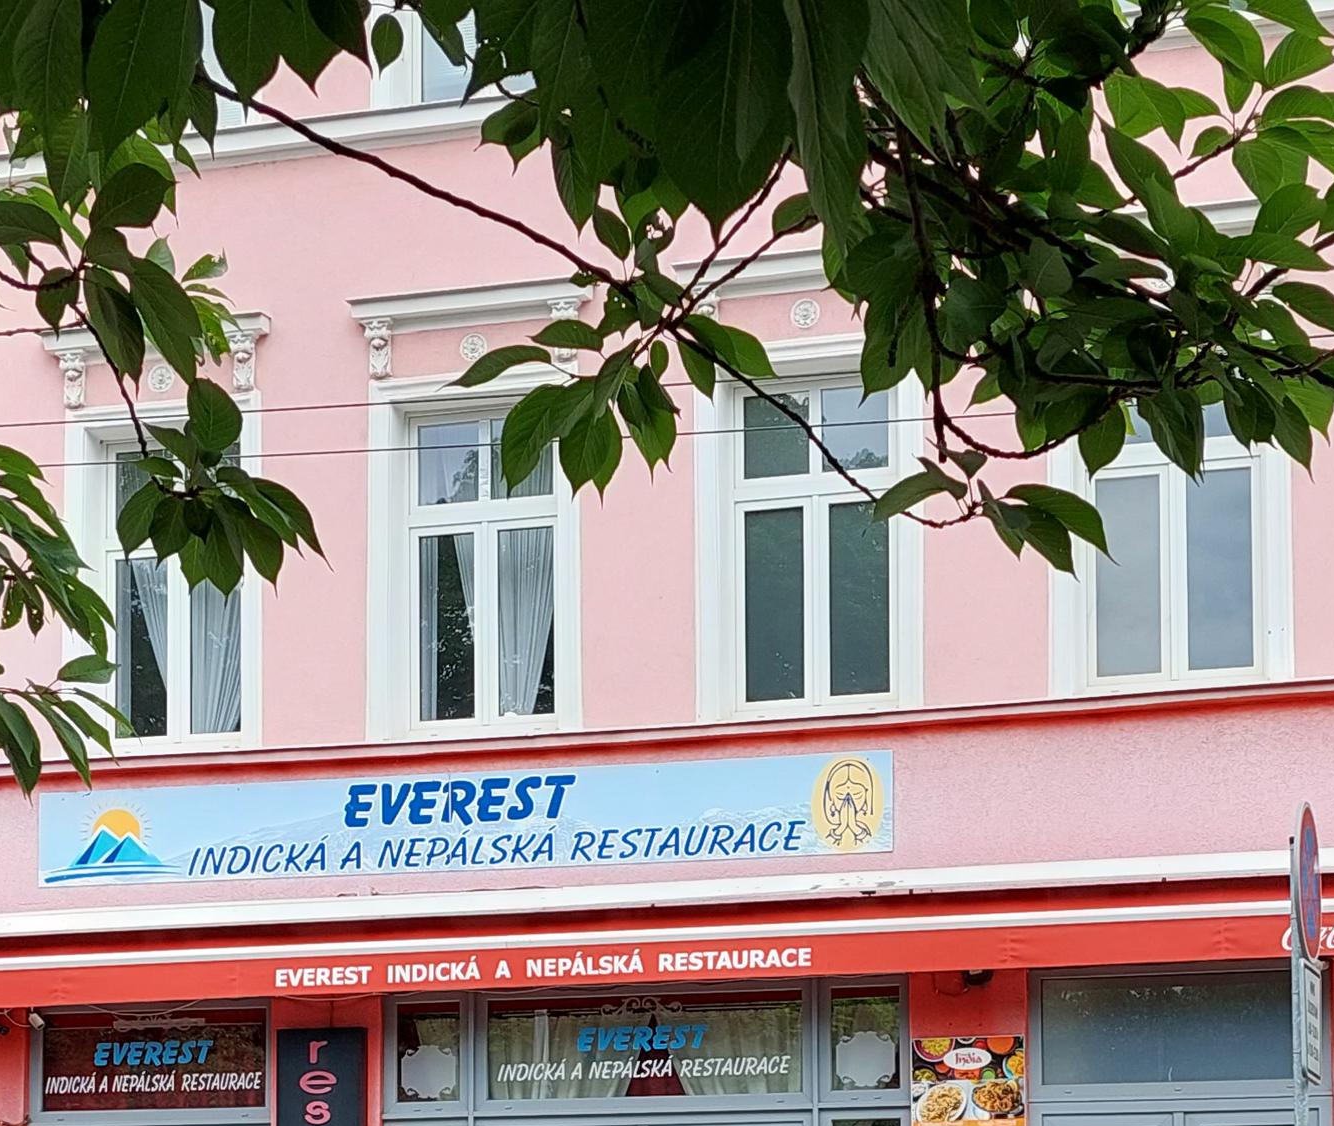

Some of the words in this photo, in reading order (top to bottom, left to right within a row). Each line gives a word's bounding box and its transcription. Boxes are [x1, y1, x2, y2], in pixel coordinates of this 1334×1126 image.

[343, 774, 576, 829] EVEREST
[186, 832, 329, 877] INDICKÁ
[339, 842, 363, 870] A
[377, 824, 557, 868] NEPÁLSKÁ
[570, 819, 807, 860] RESTAURACE
[273, 965, 372, 988] EVEREST
[386, 954, 481, 984] INDICKÁ
[495, 960, 511, 979] A
[525, 948, 644, 978] NEPÁLSKÁ
[657, 947, 812, 973] RESTAURACE
[577, 1024, 710, 1052] EVEREST
[93, 1039, 214, 1067] EVEREST
[45, 1072, 97, 1094] INDICKÁ
[99, 1076, 108, 1093] A
[112, 1070, 176, 1093] NEPÁLSKÁ
[181, 1071, 262, 1092] RESTAURACE
[497, 1058, 567, 1082] INDICKÁ
[570, 1062, 582, 1080] A
[588, 1055, 674, 1079] NEPÁLSKÁ
[680, 1055, 791, 1077] RESTAURACE
